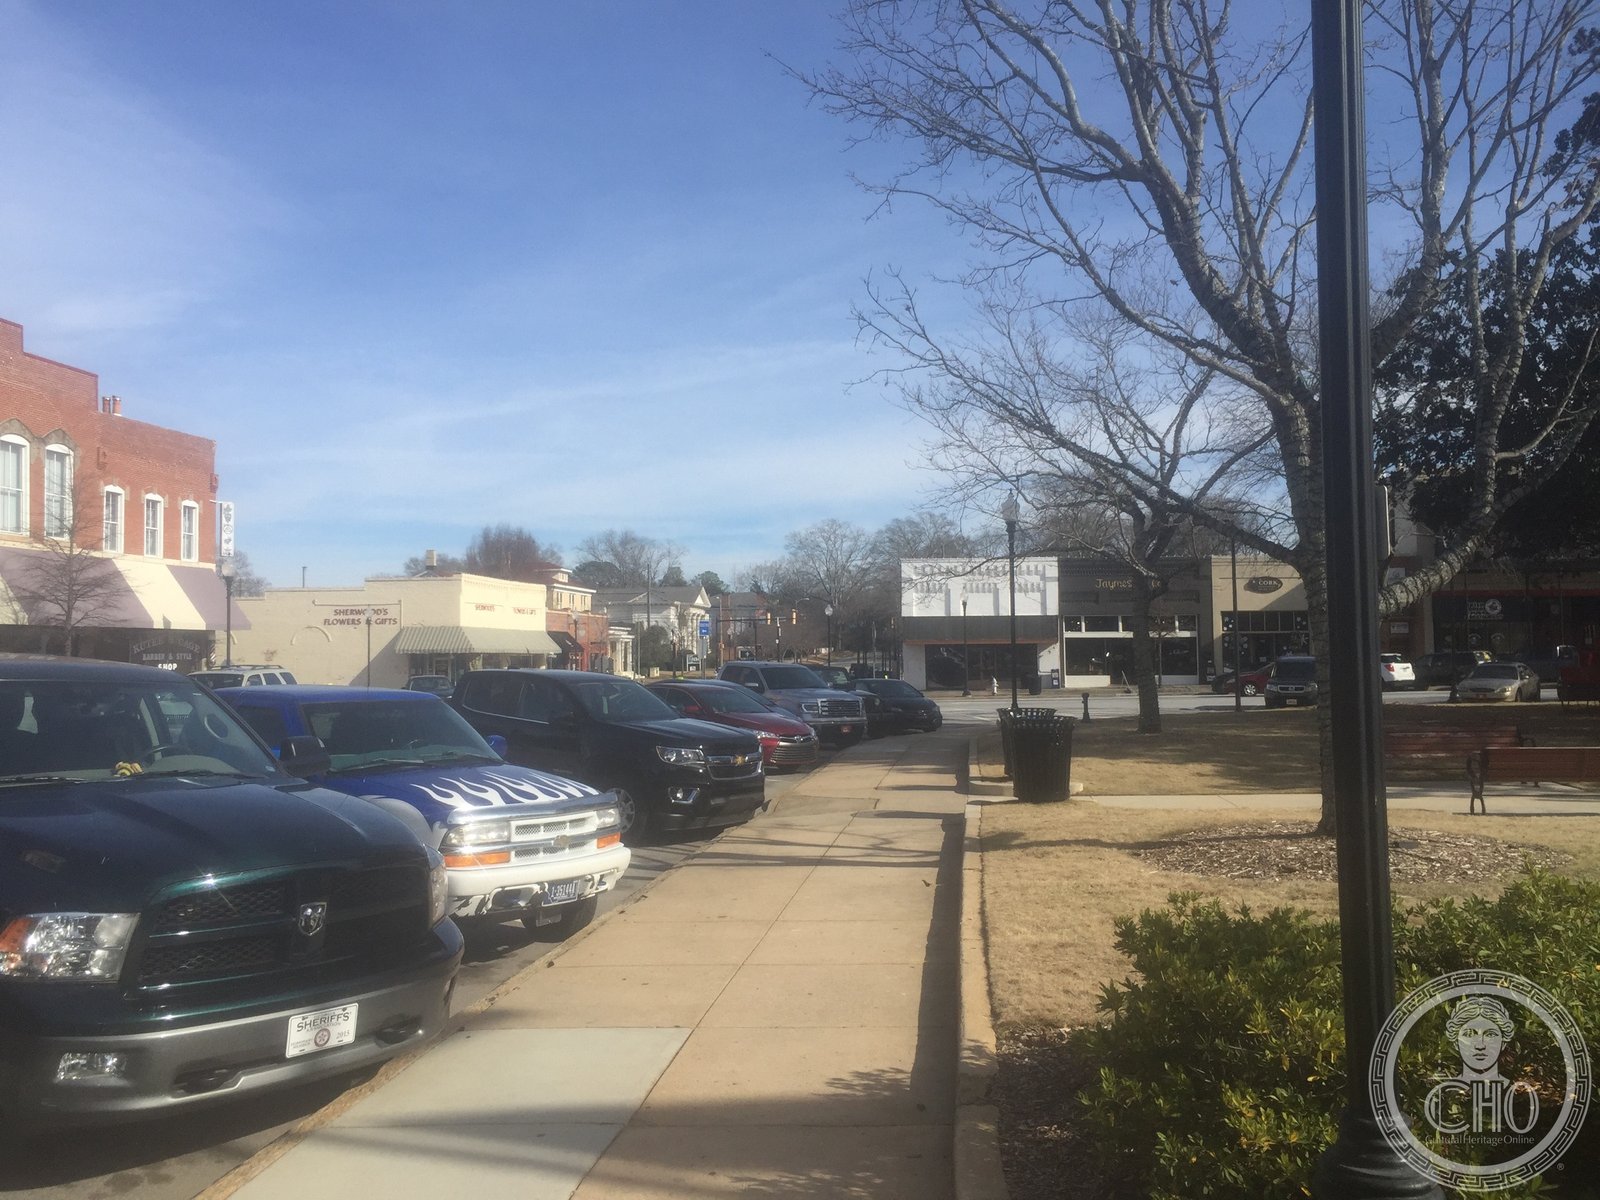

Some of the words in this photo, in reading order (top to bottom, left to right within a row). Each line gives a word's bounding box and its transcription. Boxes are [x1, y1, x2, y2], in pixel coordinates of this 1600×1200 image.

[323, 617, 362, 626] FLOWERS
[374, 617, 398, 625] GIFTS
[157, 663, 178, 671] SHOP
